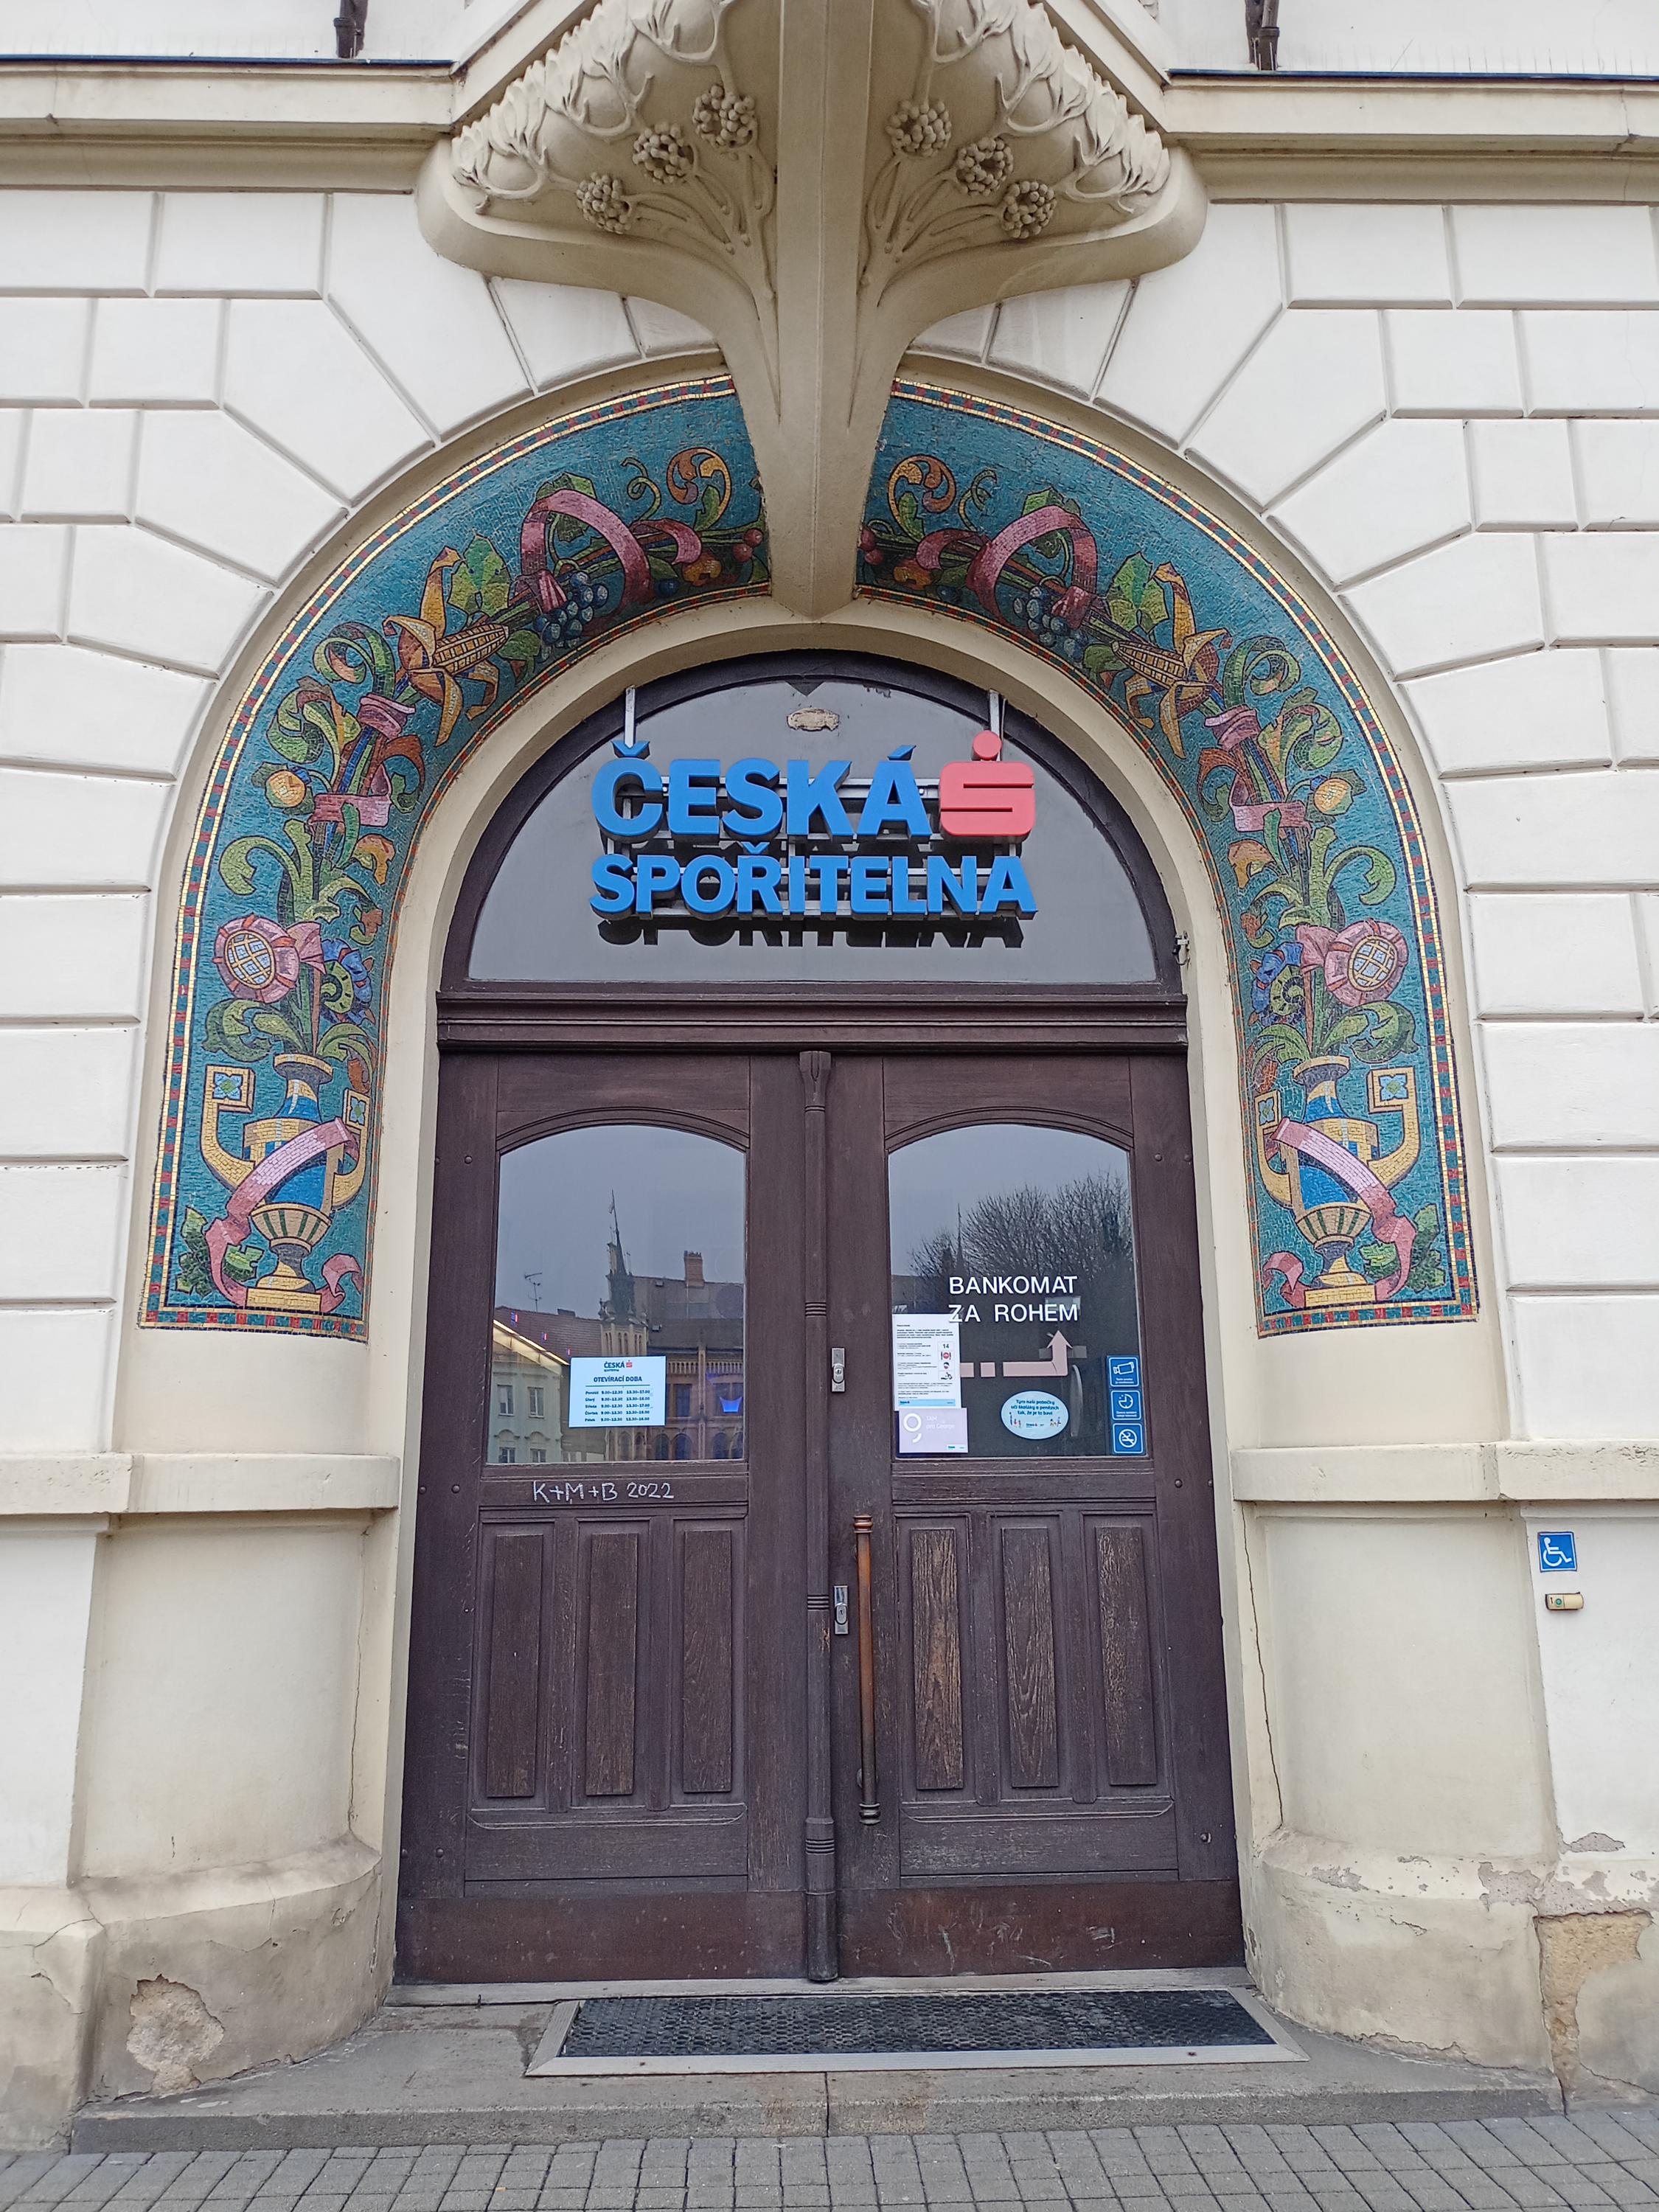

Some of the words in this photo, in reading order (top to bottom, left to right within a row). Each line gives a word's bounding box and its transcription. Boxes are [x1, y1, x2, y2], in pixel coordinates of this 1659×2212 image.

[591, 740, 932, 839] ČESKÁ
[590, 842, 1038, 915] SPOŘITELNA
[948, 1275, 1078, 1294] BANKOMAT
[947, 1303, 981, 1323] ZA
[994, 1303, 1079, 1322] ROHEM
[604, 1360, 625, 1368] ČESKÁ
[627, 1481, 675, 1498] 2022
